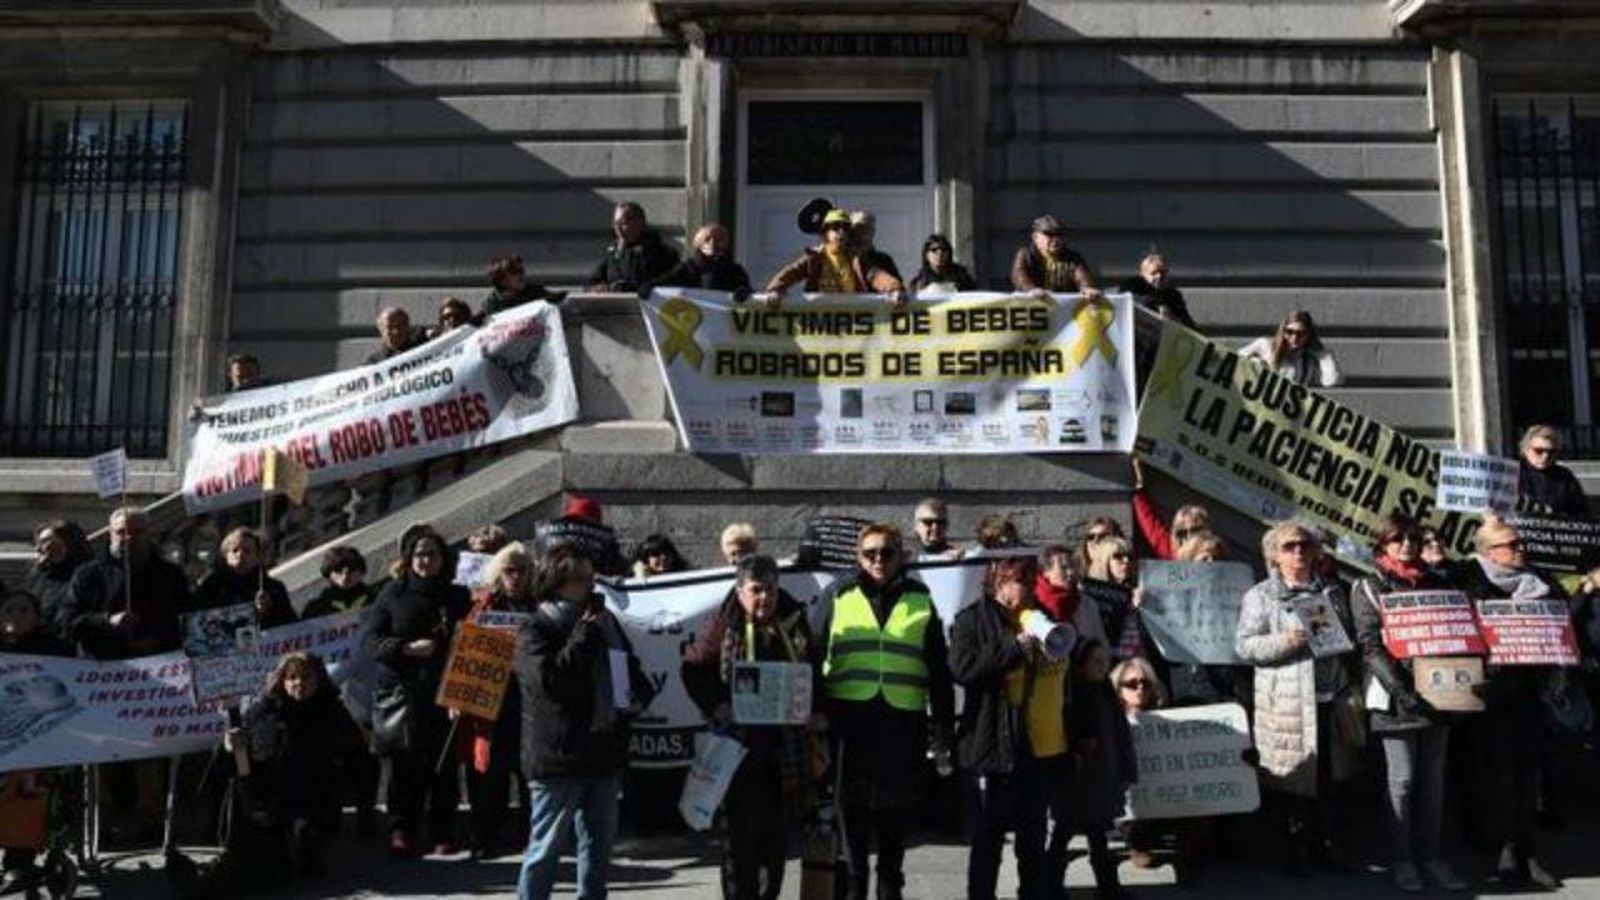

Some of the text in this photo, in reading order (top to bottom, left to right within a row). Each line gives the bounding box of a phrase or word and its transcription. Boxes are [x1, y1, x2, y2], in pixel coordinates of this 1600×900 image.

[732, 308, 1049, 337] VICTIMAS DE BEBES
[715, 338, 1064, 377] ROBADOS DE ESPAÑA
[1195, 341, 1239, 390] LA
[1242, 368, 1382, 458] JUSTICIA
[329, 416, 386, 464] ROBO
[387, 409, 419, 449] DE
[1184, 386, 1228, 438] LA
[1227, 408, 1390, 515] PACIENCIA
[451, 655, 507, 685] ROBO
